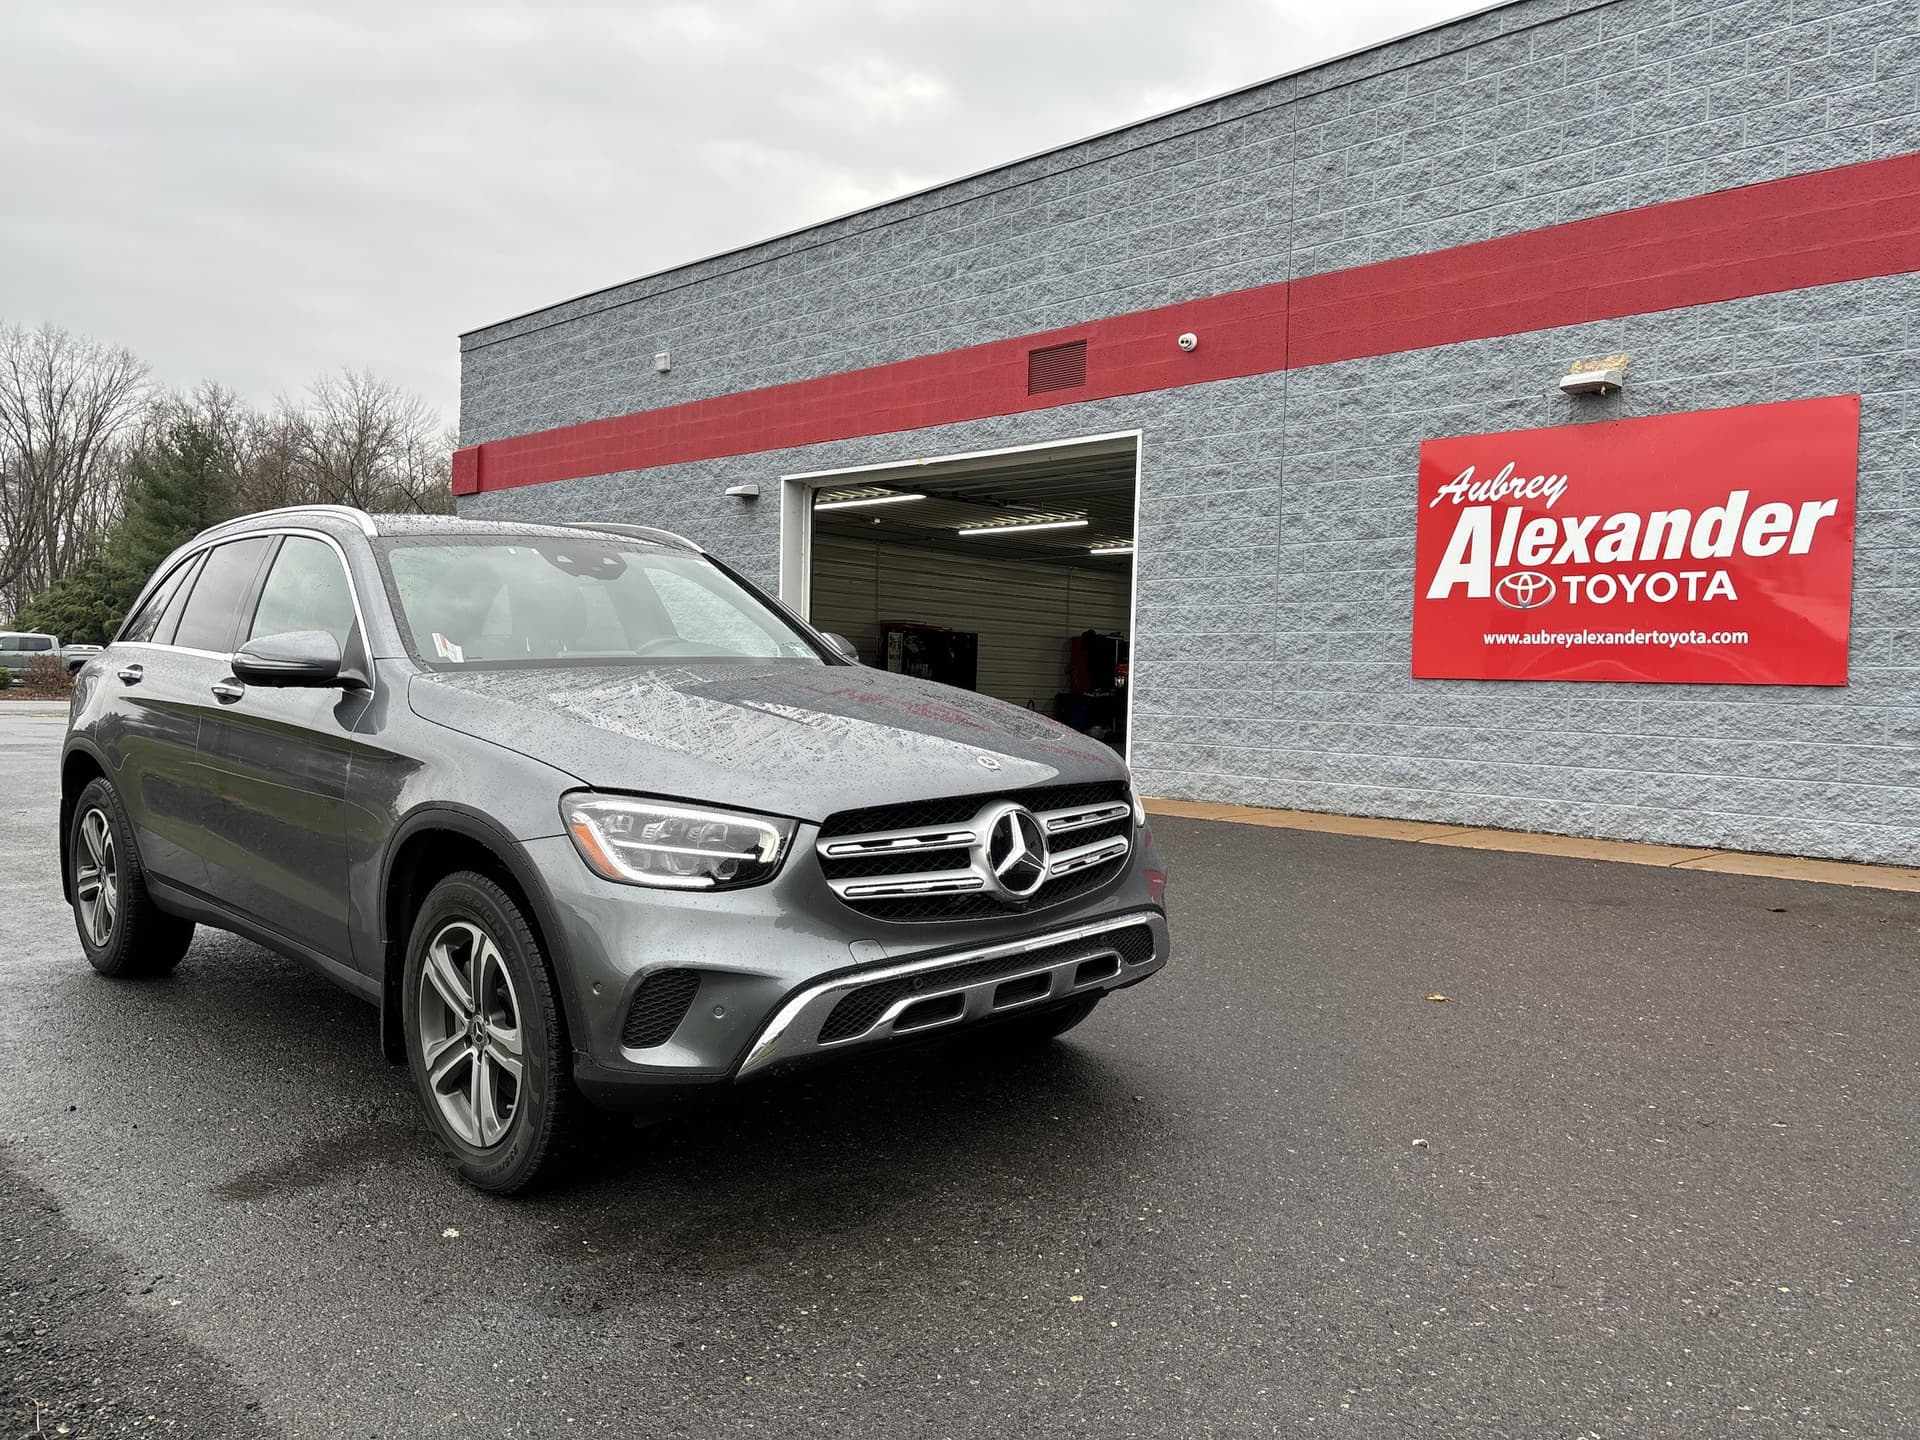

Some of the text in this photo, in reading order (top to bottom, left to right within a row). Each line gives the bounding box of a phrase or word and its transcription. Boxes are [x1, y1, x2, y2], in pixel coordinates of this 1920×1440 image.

[1429, 461, 1568, 509] Aubrey
[1426, 489, 1839, 600] Alexander
[1561, 571, 1738, 604] TOYOTA
[1483, 628, 1749, 649] www.aubreyalexandertoyota.com
